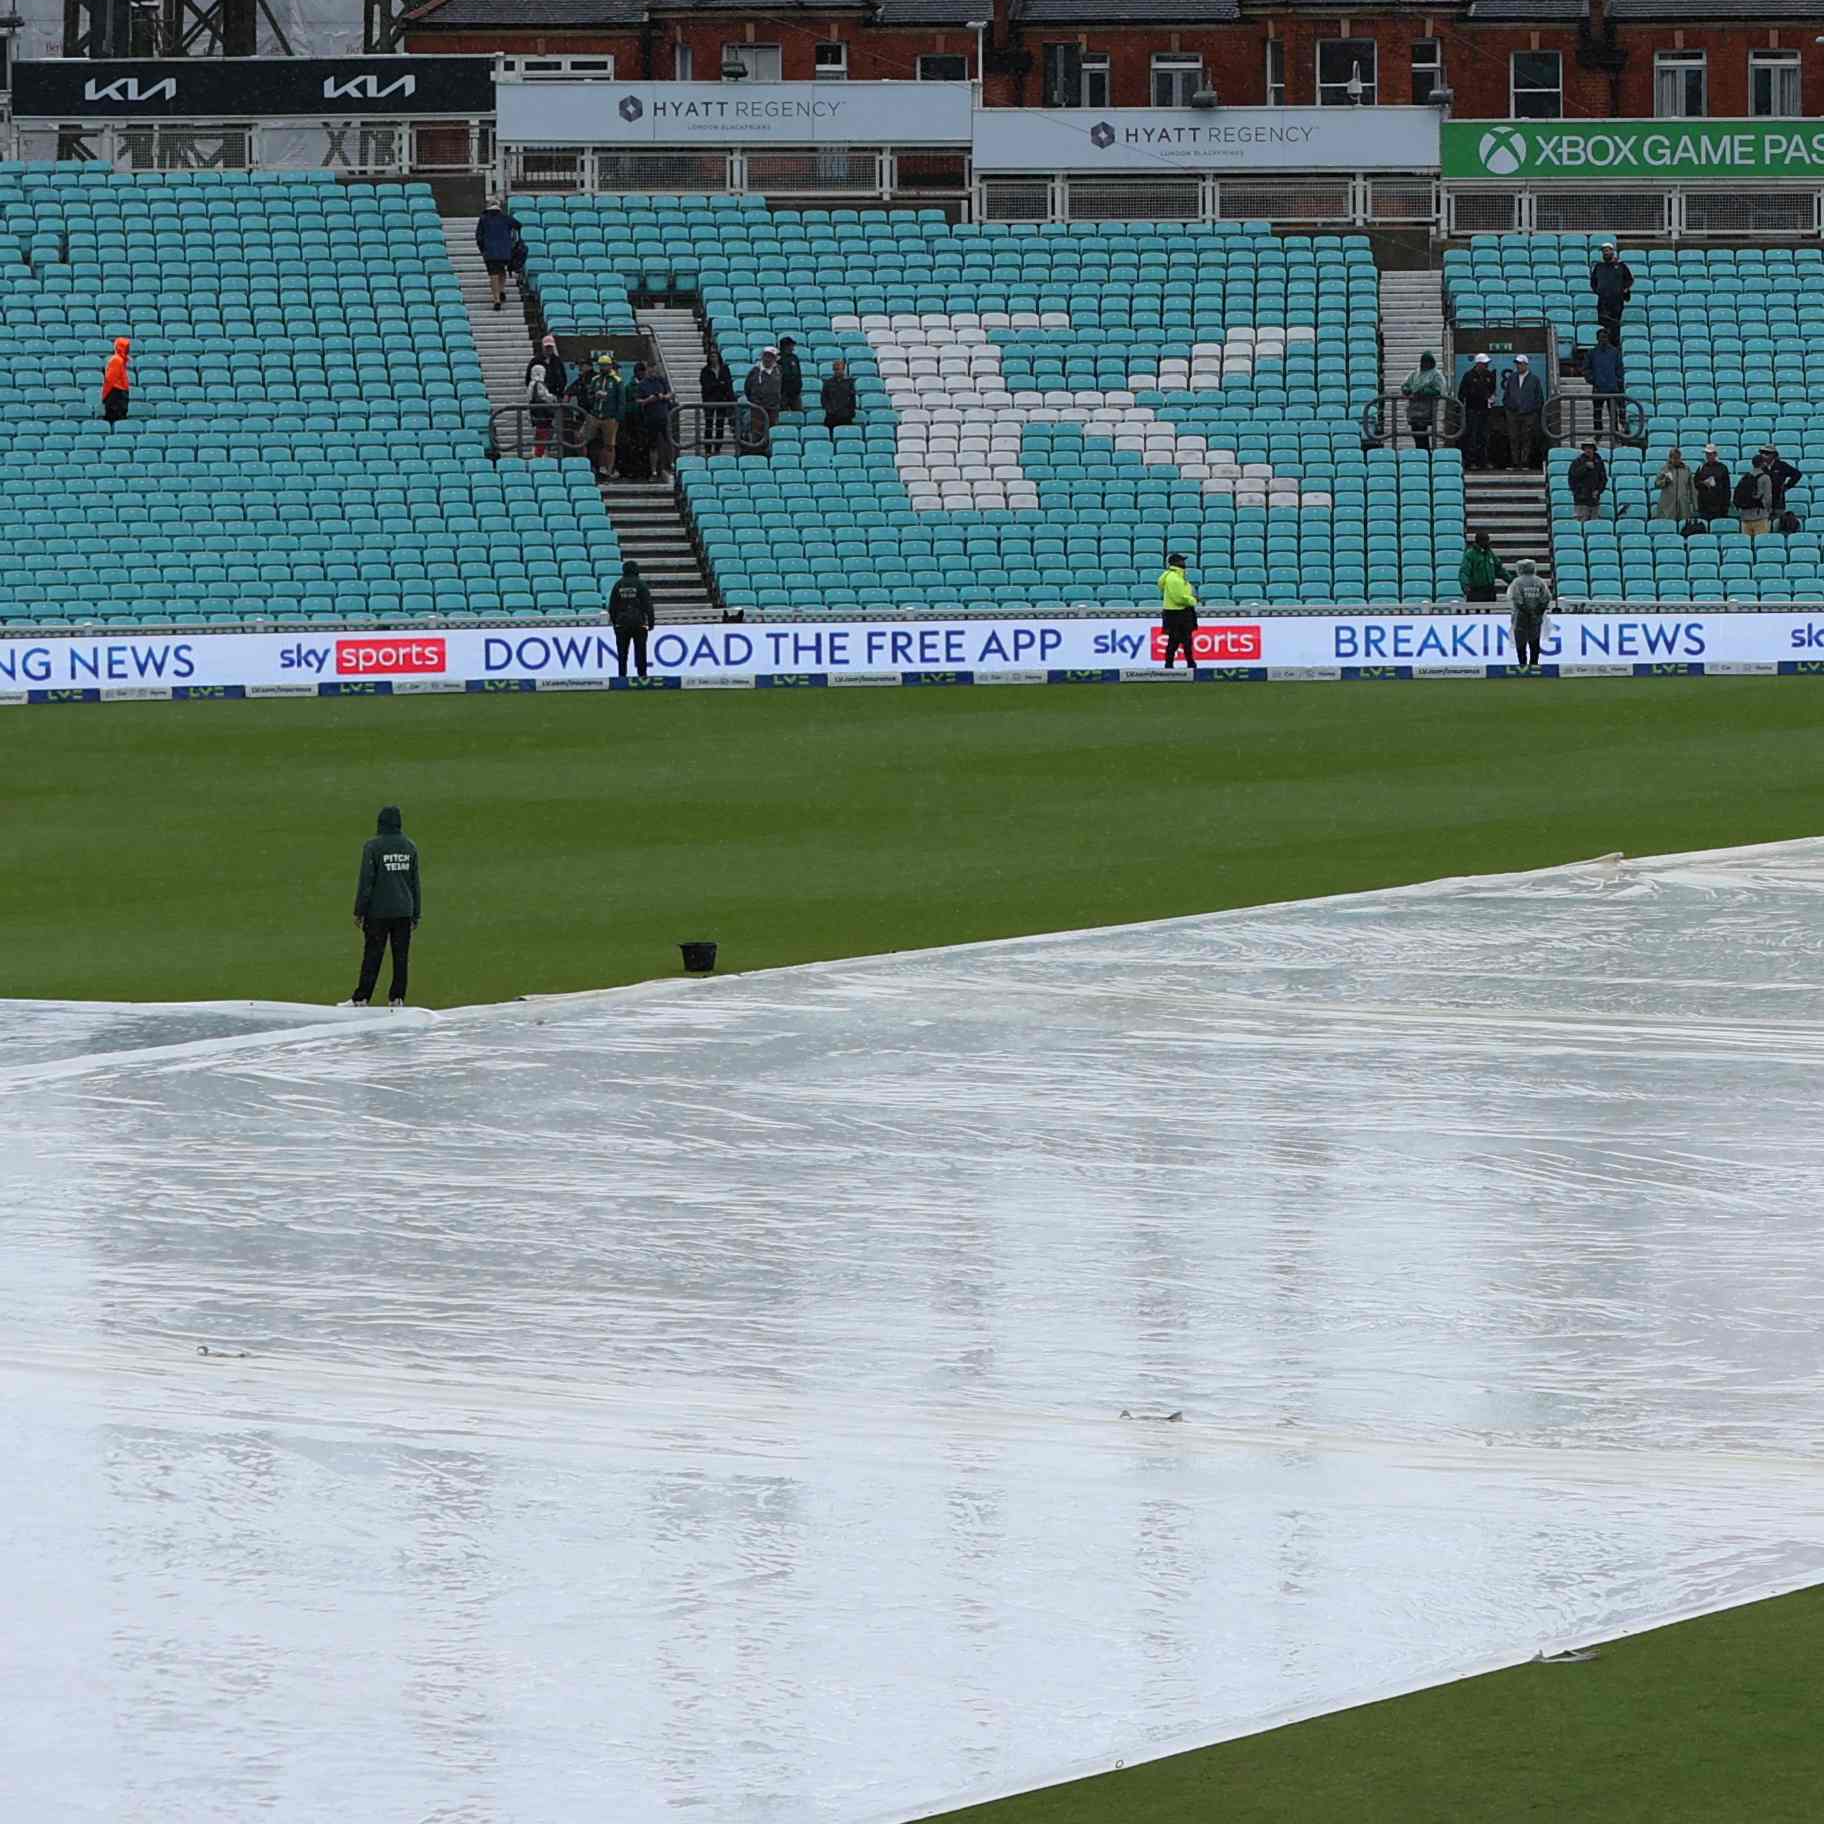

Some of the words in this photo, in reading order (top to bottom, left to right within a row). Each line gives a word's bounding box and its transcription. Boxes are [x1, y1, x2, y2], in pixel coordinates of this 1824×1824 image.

[653, 101, 729, 117] HYATT
[736, 101, 840, 117] REGENCY
[1126, 127, 1201, 143] HYATT
[1208, 126, 1313, 143] REGENCY
[1535, 135, 1639, 166] XBOX
[1642, 134, 1755, 166] GAME
[766, 632, 850, 665] THE
[866, 630, 966, 664] FREE
[978, 628, 1063, 662] APP
[1093, 628, 1146, 660] sky
[1156, 631, 1255, 658] sorts
[1581, 622, 1706, 657] NEWS
[70, 645, 195, 680] NEWS
[280, 642, 331, 674] sky
[341, 642, 440, 671] sports
[383, 854, 410, 863] PITCH
